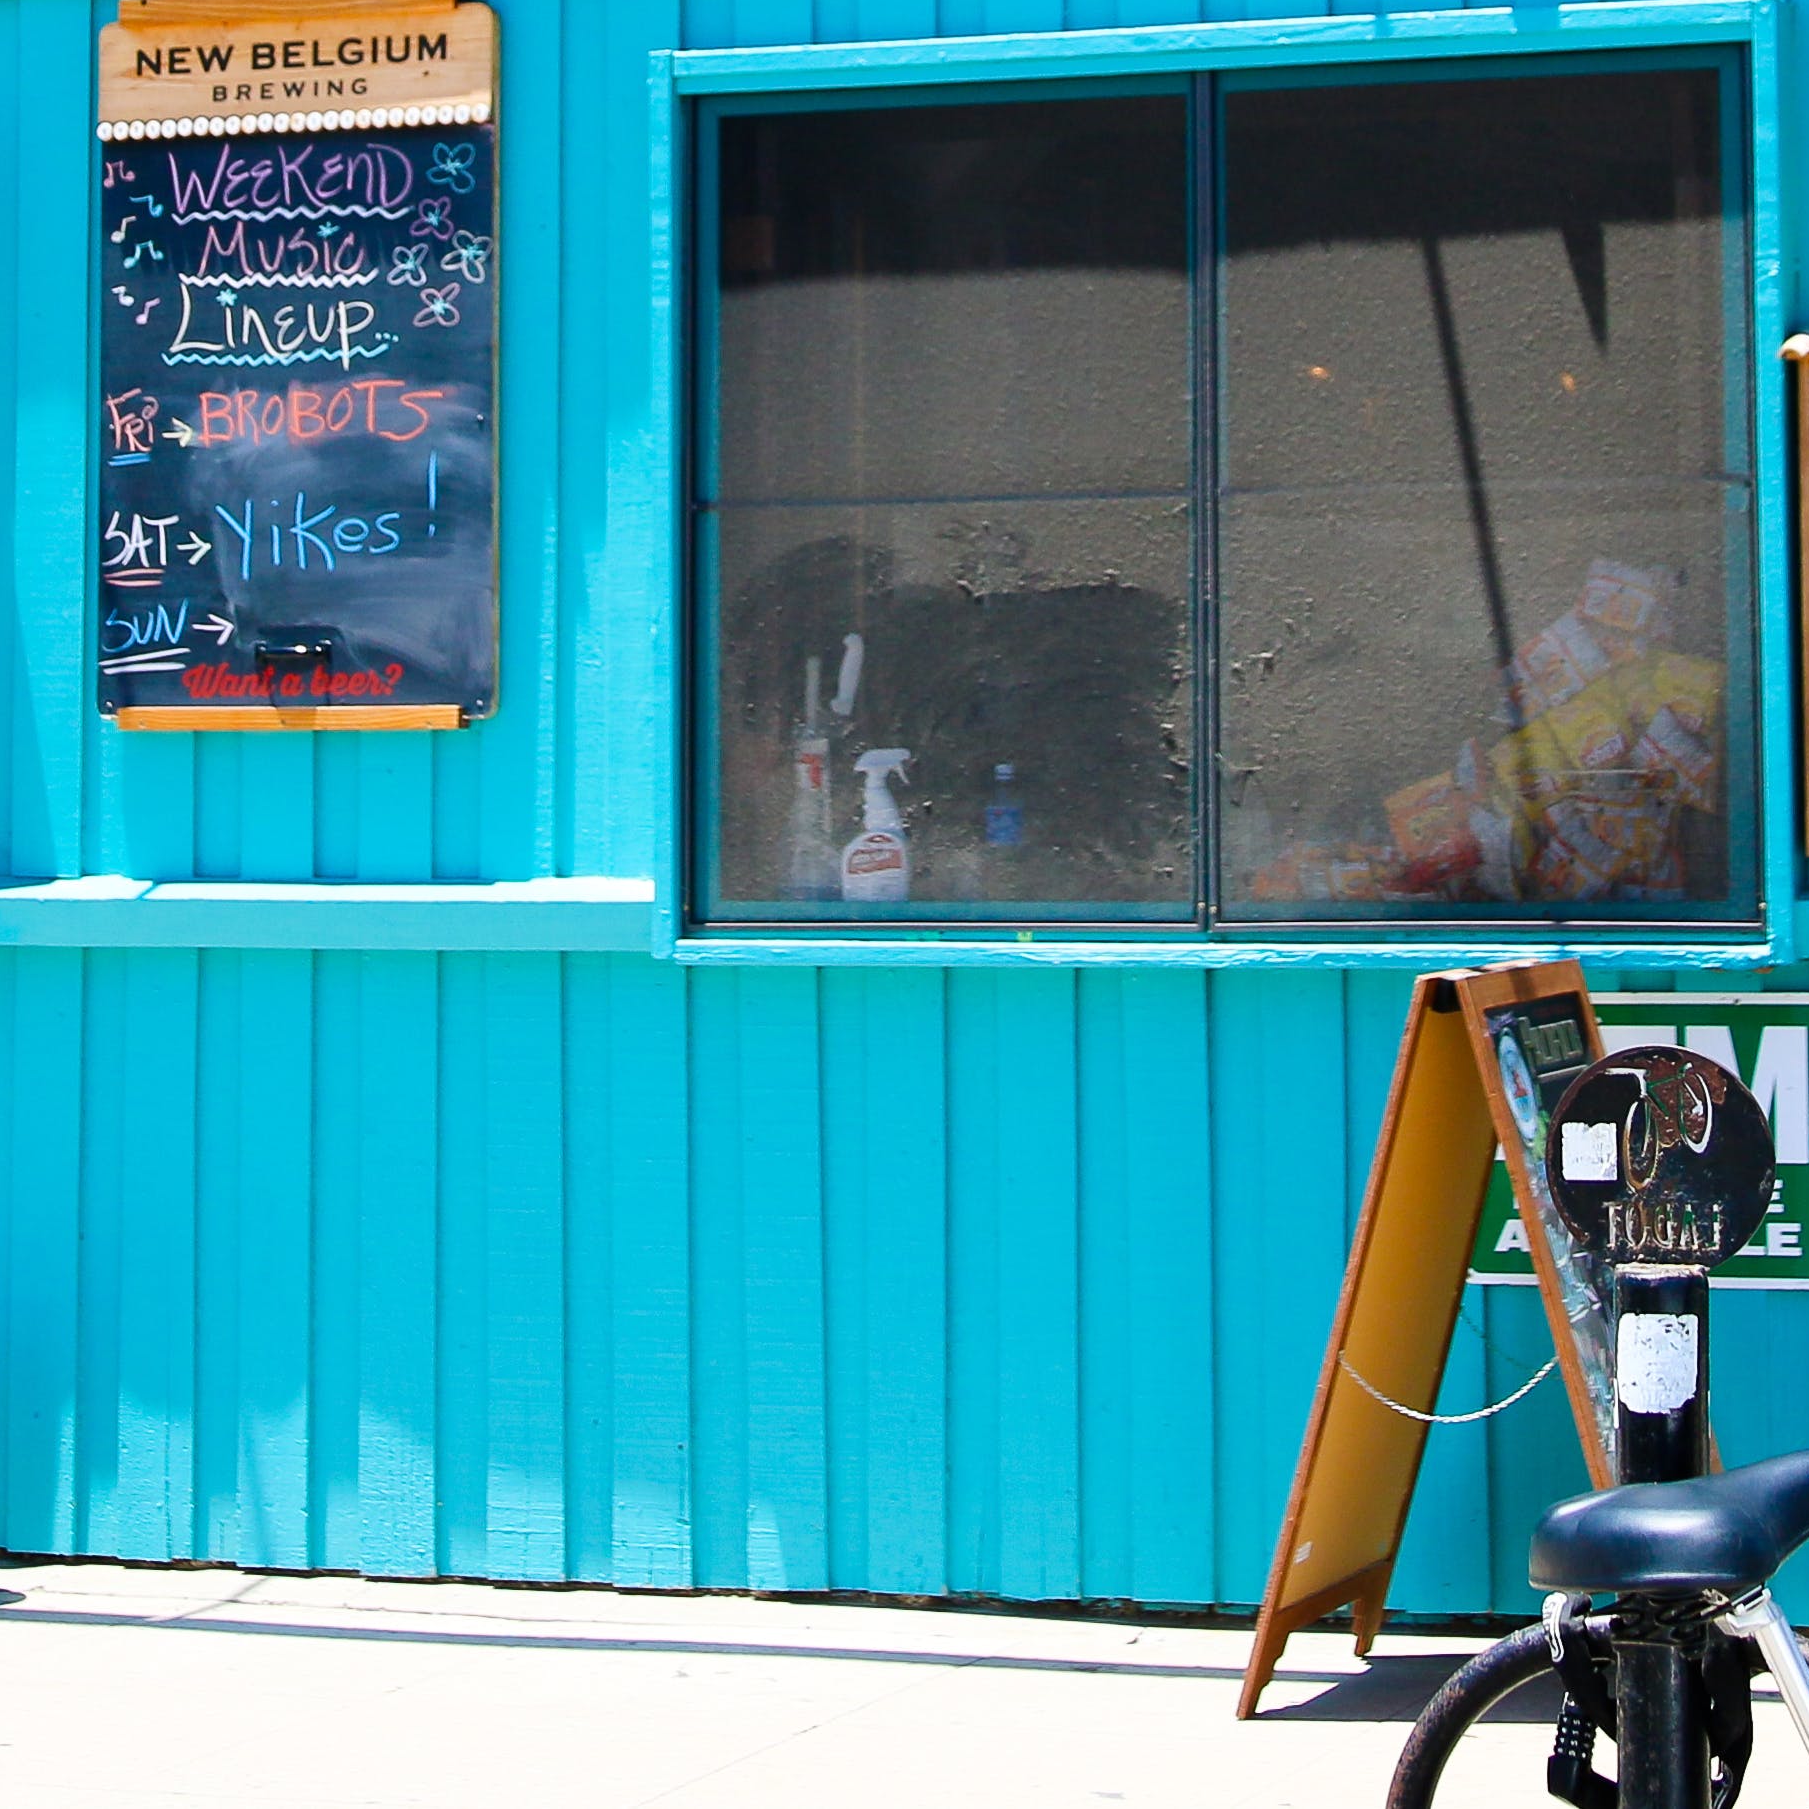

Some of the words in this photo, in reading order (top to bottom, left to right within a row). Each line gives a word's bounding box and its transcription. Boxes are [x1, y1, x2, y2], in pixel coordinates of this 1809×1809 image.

[137, 45, 235, 76] NEW
[252, 33, 448, 69] BELGIUM
[212, 78, 368, 102] BREWING
[169, 143, 413, 214] WEEKEND
[199, 380, 443, 445] BROBOTS
[103, 511, 179, 567] SAT
[104, 600, 188, 652] SUN
[182, 664, 274, 698] Want
[280, 674, 303, 695] a
[314, 664, 403, 698] beer?
